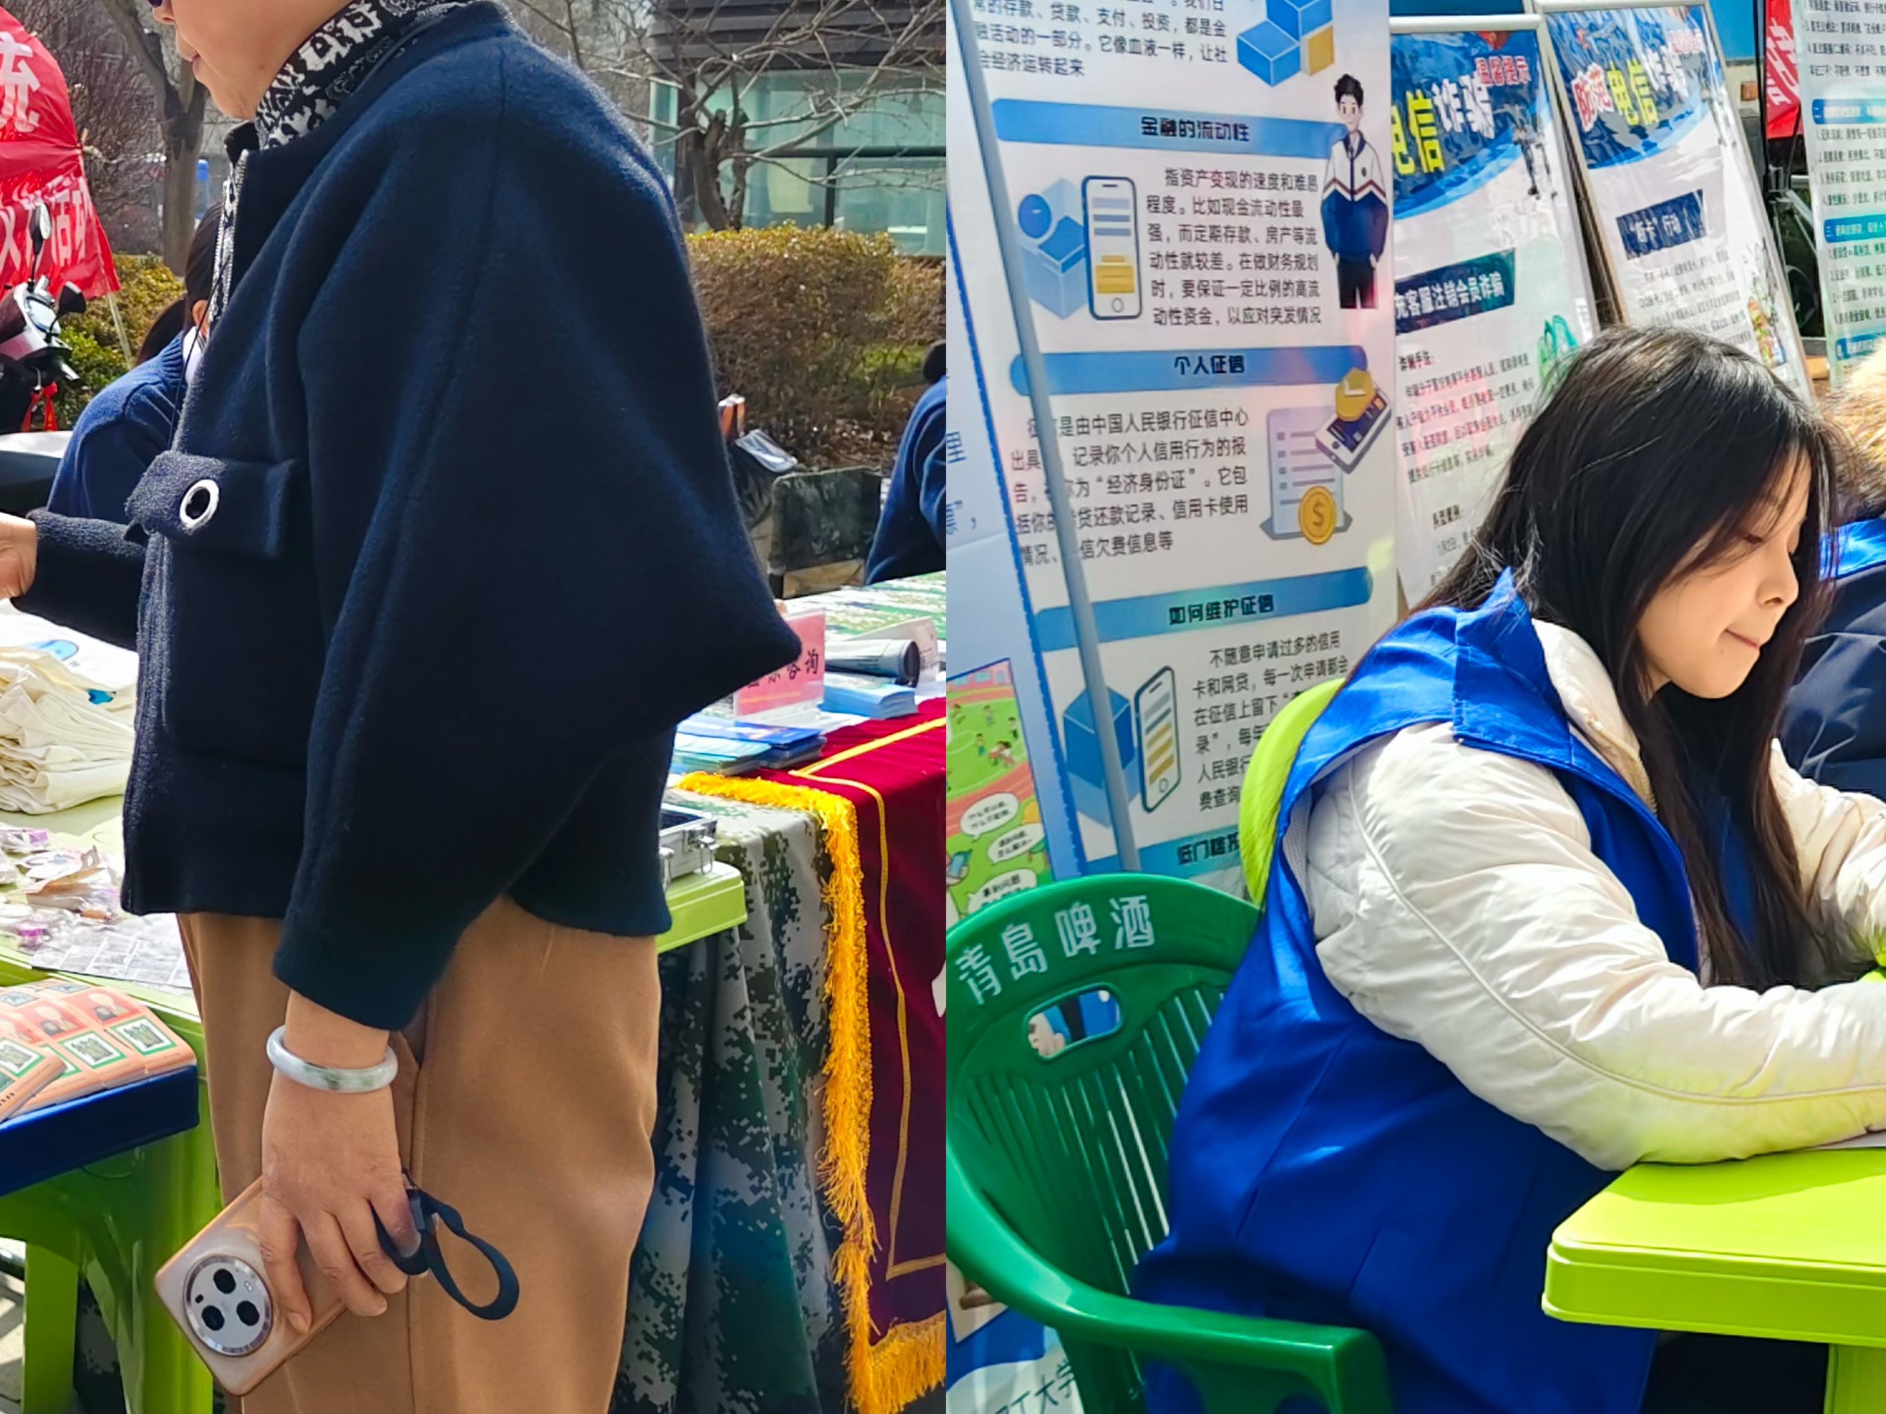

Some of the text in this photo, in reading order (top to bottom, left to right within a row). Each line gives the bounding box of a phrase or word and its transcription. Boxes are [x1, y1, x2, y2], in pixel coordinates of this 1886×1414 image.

[1141, 115, 1250, 142] 金融的流动性
[1173, 355, 1246, 376] 个人征信
[1168, 593, 1275, 626] 如何维护征信
